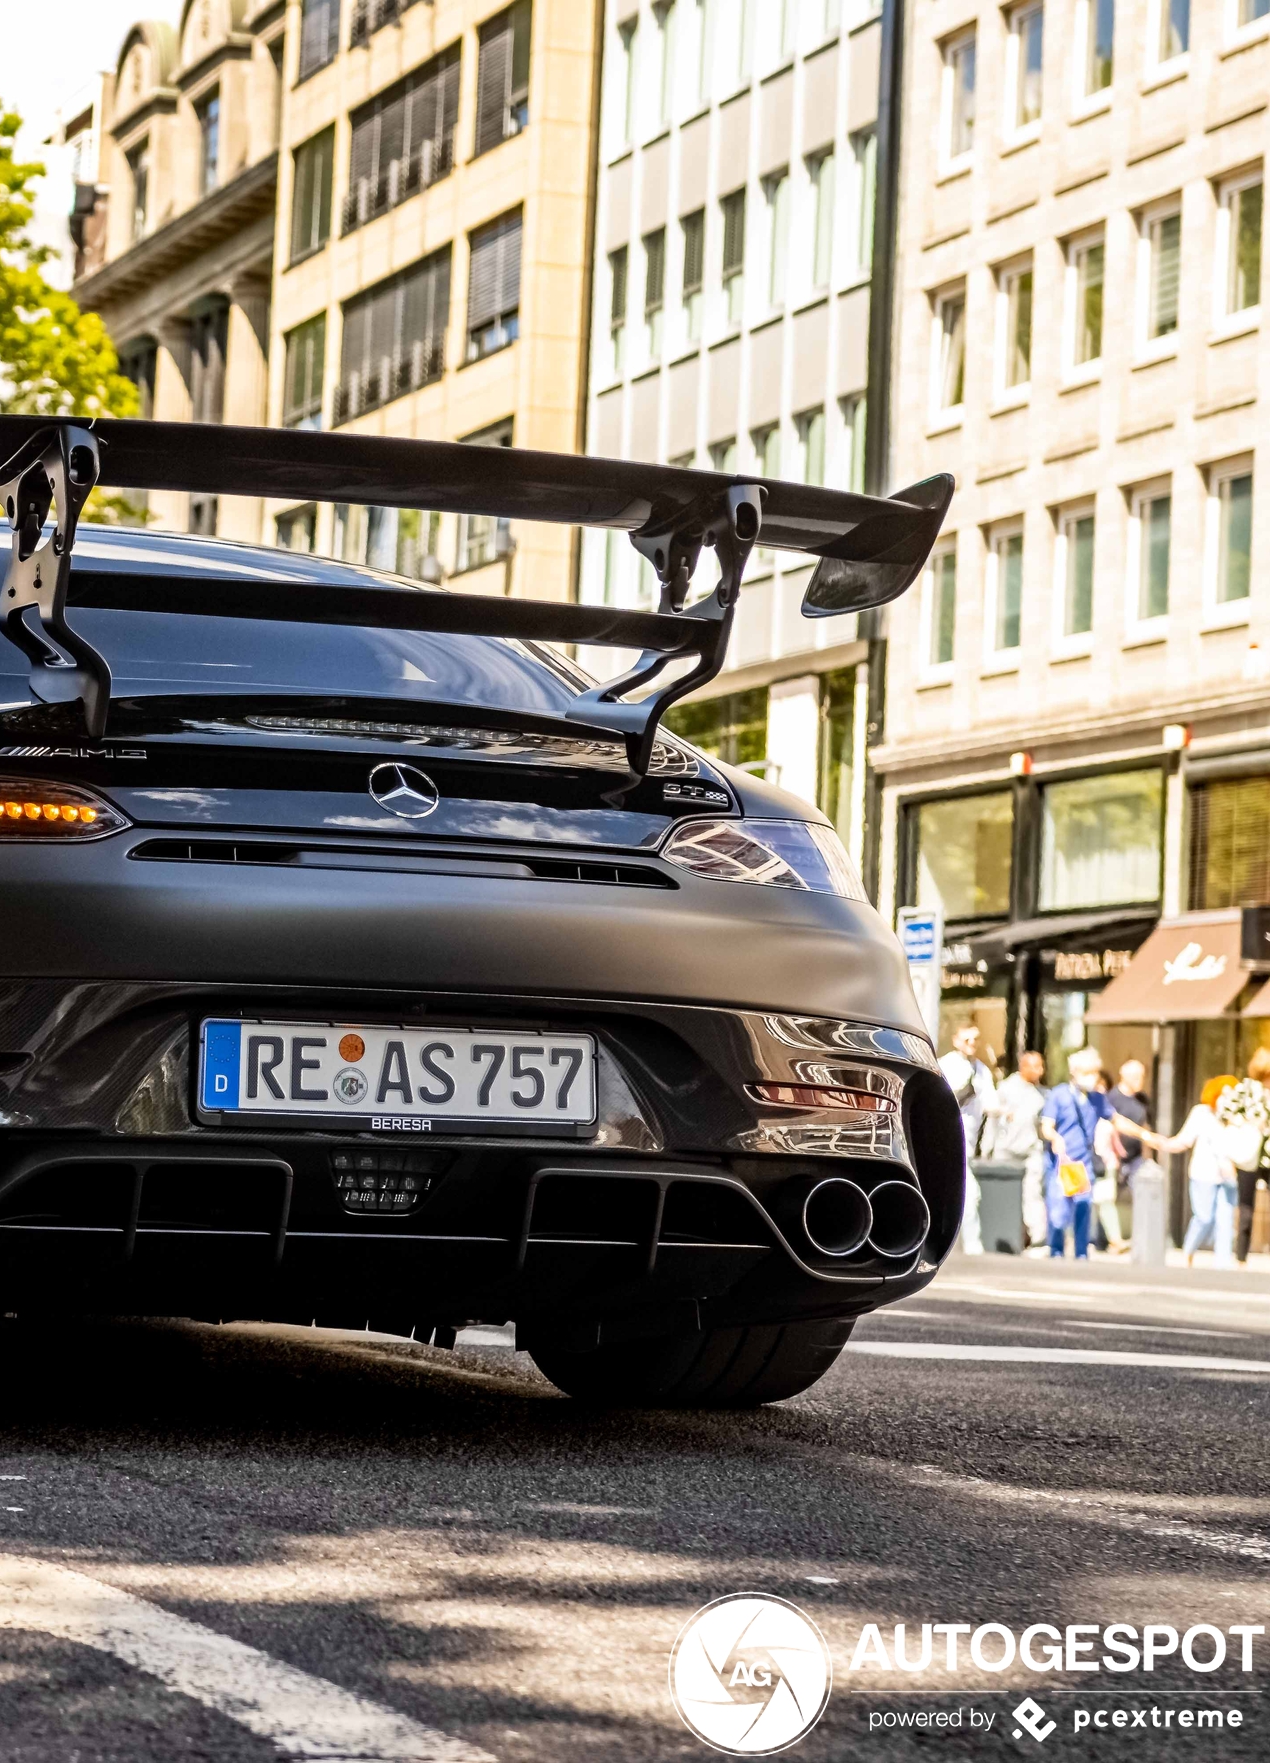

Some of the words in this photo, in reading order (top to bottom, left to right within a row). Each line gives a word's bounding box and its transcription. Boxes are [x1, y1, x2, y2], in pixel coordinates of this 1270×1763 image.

[245, 1035, 329, 1100] RE
[376, 1040, 457, 1105] AS
[472, 1043, 584, 1109] 757
[214, 1074, 229, 1094] D
[371, 1117, 432, 1132] BERESA
